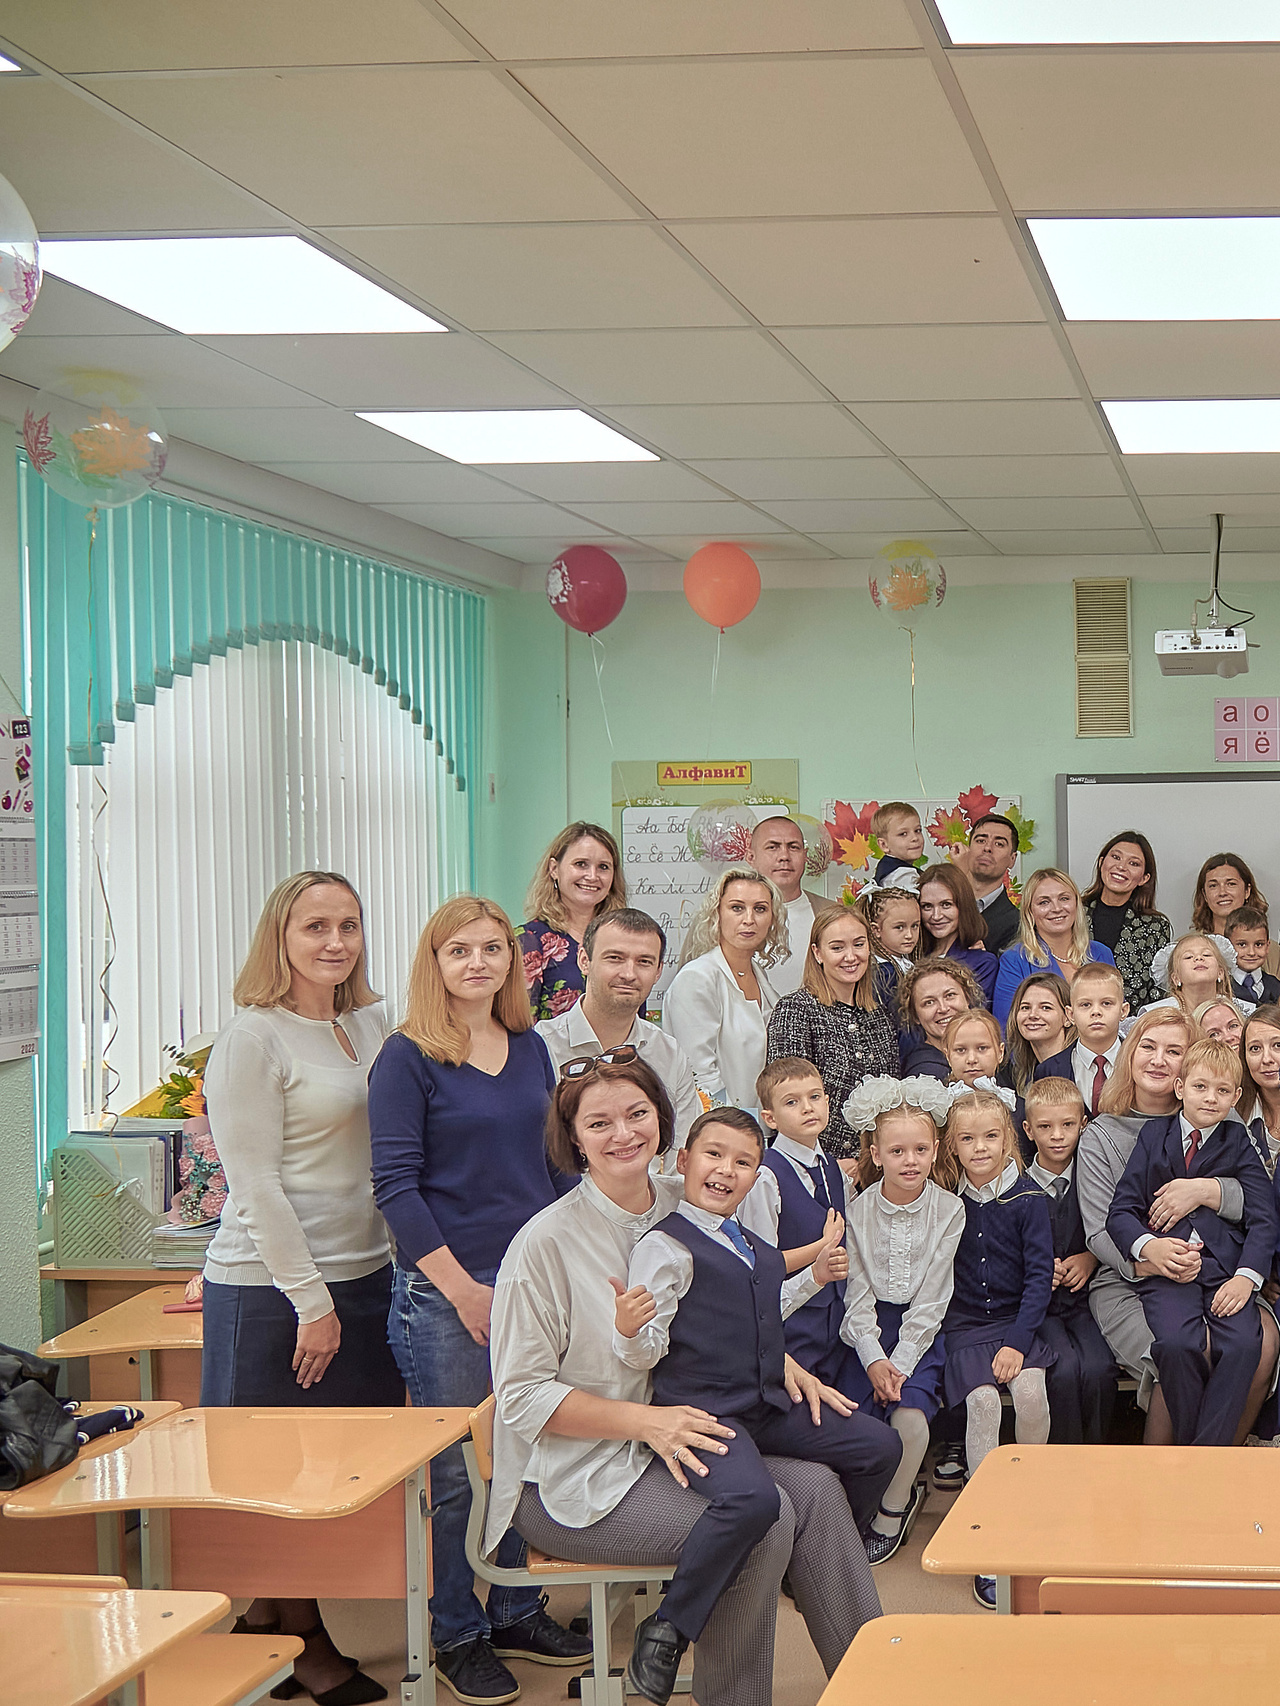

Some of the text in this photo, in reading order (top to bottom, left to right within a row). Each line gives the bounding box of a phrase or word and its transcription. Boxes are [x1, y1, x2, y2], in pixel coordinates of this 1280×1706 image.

[1222, 705, 1238, 722] а
[1253, 704, 1269, 721] о
[1222, 736, 1238, 754] я
[1254, 731, 1270, 753] ё
[636, 817, 660, 834] Аа
[626, 846, 642, 863] Ее
[648, 843, 664, 863] Ёё
[636, 878, 657, 894] Кк
[21, 1043, 35, 1055] 2022
